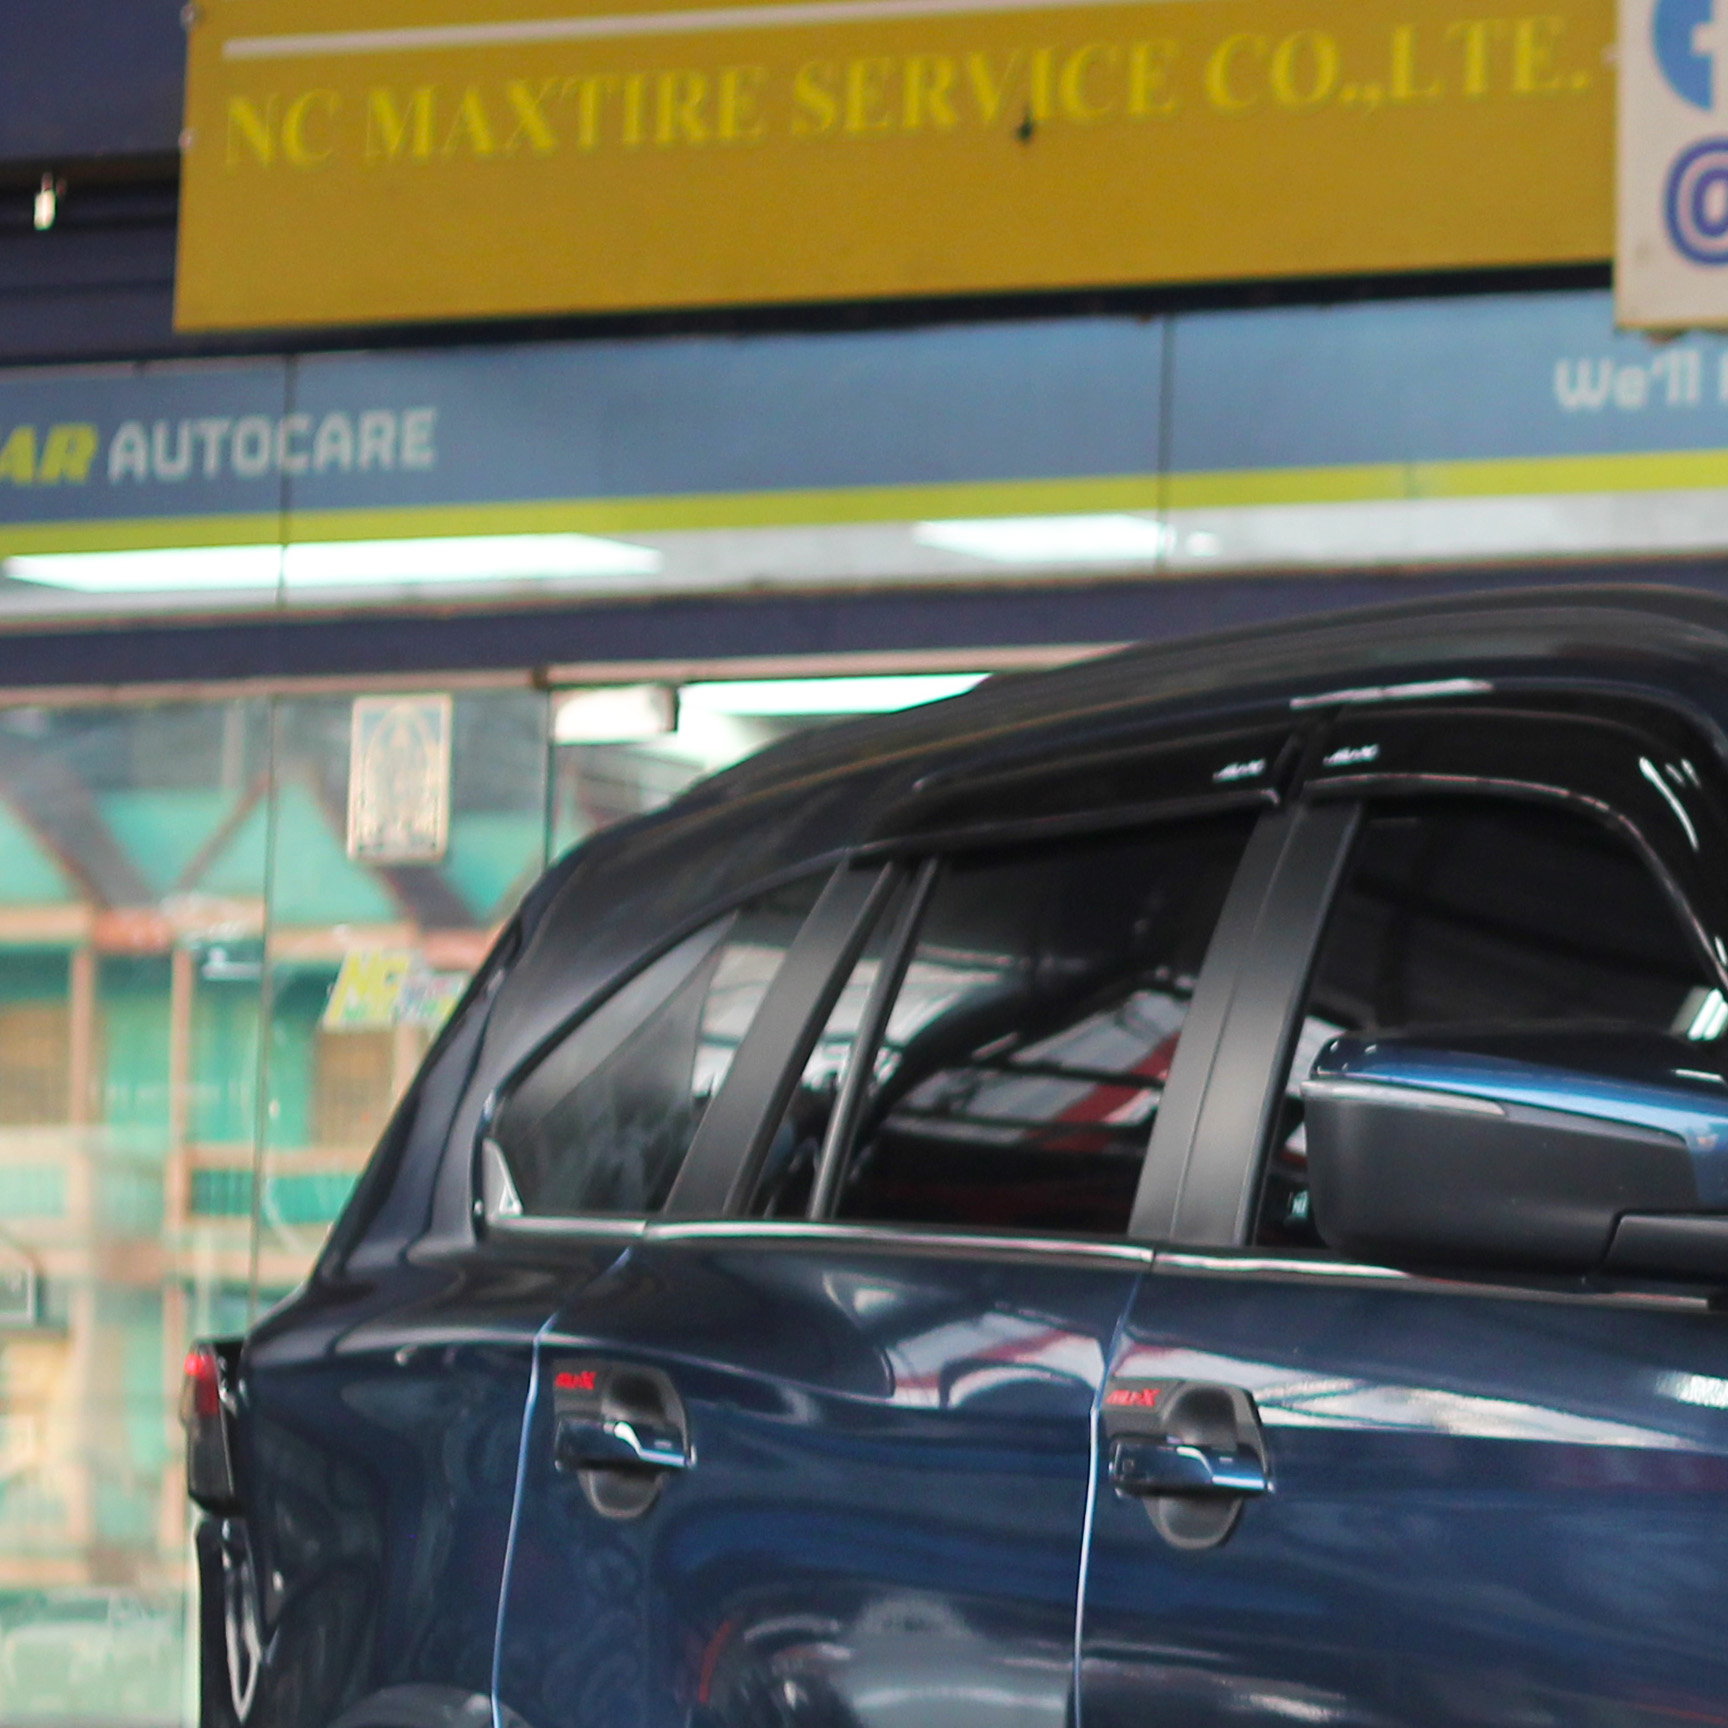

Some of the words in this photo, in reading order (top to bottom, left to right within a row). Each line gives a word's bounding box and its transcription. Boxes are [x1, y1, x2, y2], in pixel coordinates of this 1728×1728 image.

[224, 87, 340, 170] NC
[364, 65, 767, 162] MAXTIRE
[793, 39, 1181, 134] SERVICE
[108, 407, 438, 485] AUTOCARE
